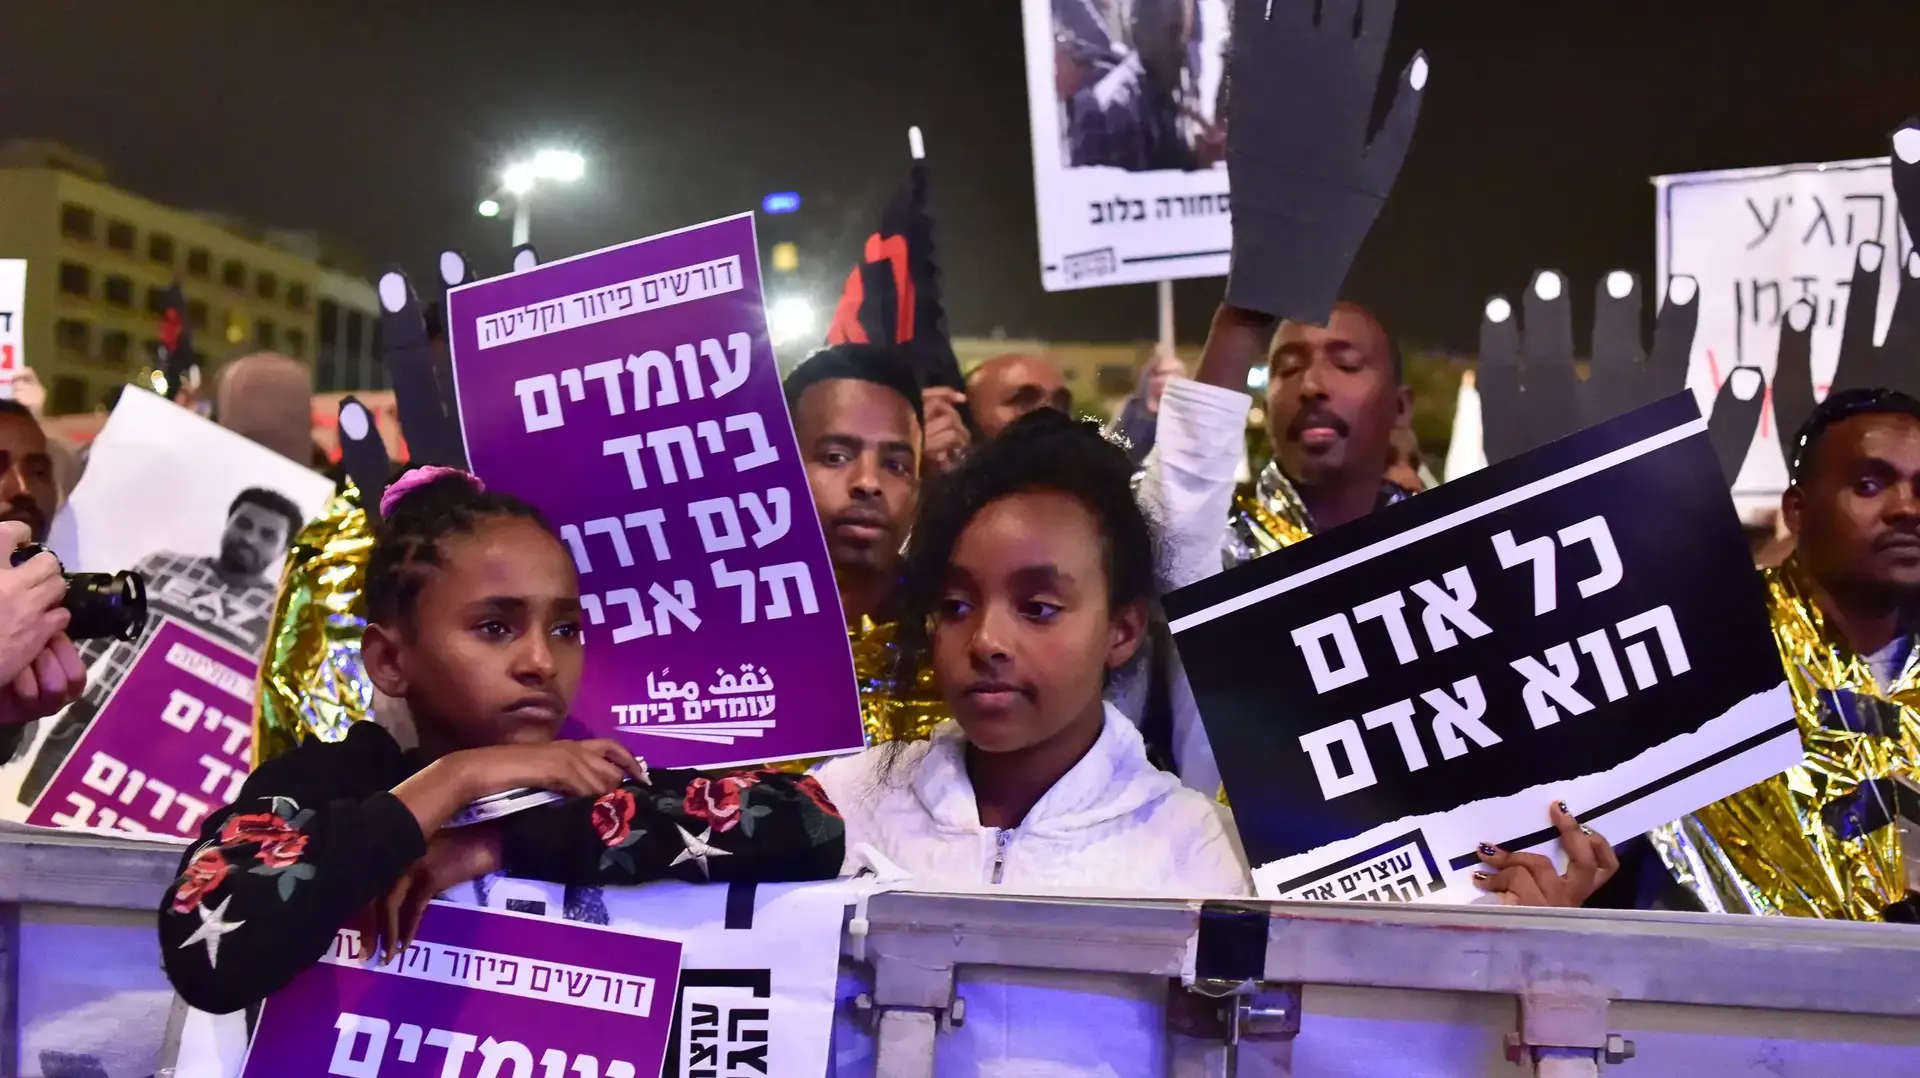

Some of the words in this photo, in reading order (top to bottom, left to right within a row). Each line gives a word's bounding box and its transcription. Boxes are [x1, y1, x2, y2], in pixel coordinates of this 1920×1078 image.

[1090, 194, 1145, 224] בלוב
[1746, 194, 1884, 250] הגיע
[573, 285, 633, 320] פיזור
[642, 260, 733, 304] דורשים
[485, 302, 565, 342] וקליטה
[514, 331, 752, 434] עומדים
[602, 411, 780, 490] ביחד
[560, 508, 671, 574] דרו
[688, 486, 791, 553] עם
[710, 558, 820, 624] תל
[1491, 515, 1625, 617] כל
[580, 579, 703, 645] אבי
[1290, 565, 1494, 696] אדם
[708, 663, 774, 695] نقف
[1509, 604, 1692, 731] הוא
[161, 689, 252, 765] דים
[611, 702, 676, 725] ביחד
[682, 695, 776, 721] עומדים
[1298, 674, 1504, 801] אדם
[82, 751, 208, 834] דרום
[1338, 851, 1413, 893] עוצרים
[443, 951, 519, 987] פיזור
[531, 964, 647, 1008] דורשים
[726, 1008, 769, 1078] הג
